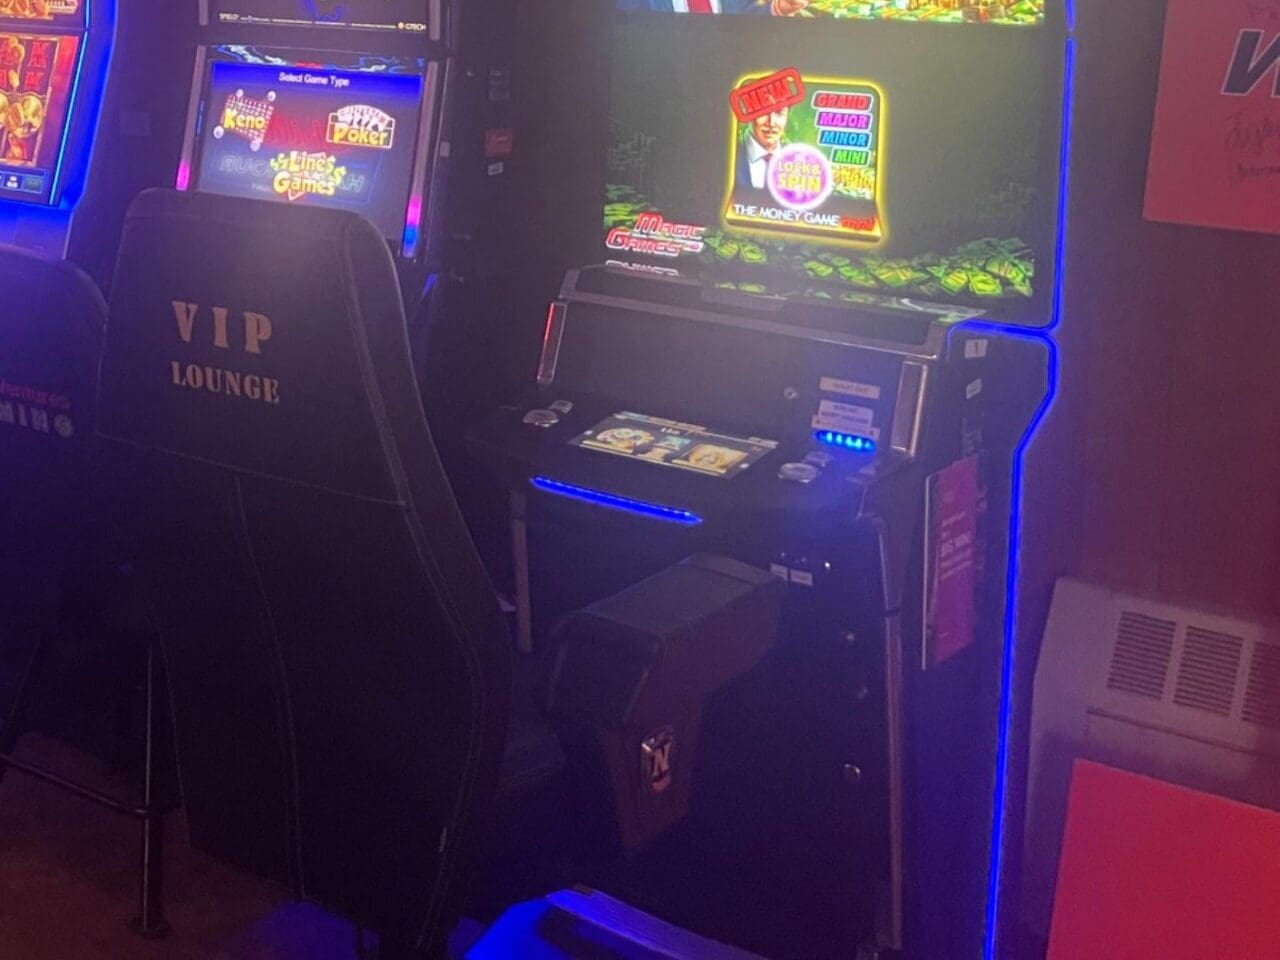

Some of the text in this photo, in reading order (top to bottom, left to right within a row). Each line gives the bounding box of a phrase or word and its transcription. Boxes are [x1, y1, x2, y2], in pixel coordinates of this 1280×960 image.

[278, 71, 351, 88] Select Game Type
[740, 77, 793, 113] NEW
[816, 94, 869, 109] GRAND
[224, 108, 266, 130] Keno
[819, 112, 869, 128] MAJOR
[332, 122, 388, 146] Poker
[822, 130, 868, 146] MINOR
[834, 150, 867, 165] MINI
[273, 171, 336, 196] Games
[777, 174, 821, 191] SPIN
[733, 204, 758, 217] THE
[759, 206, 803, 223] MONEY
[804, 212, 840, 227] GAME
[171, 300, 273, 355] VIP
[171, 360, 280, 404] LOUNGE
